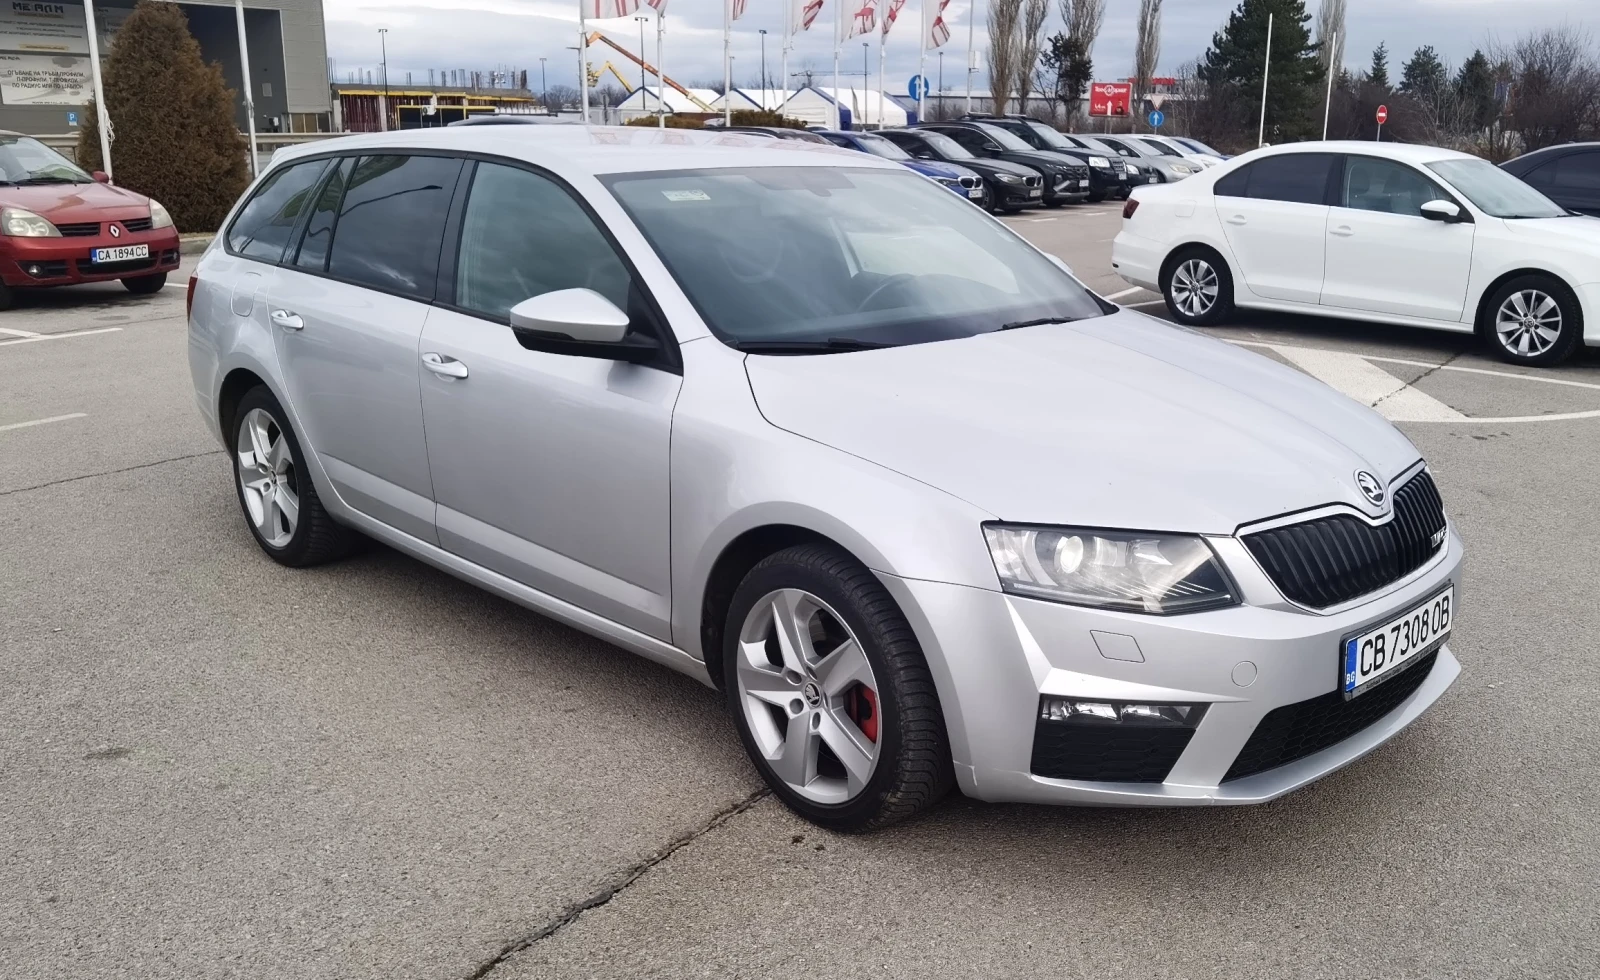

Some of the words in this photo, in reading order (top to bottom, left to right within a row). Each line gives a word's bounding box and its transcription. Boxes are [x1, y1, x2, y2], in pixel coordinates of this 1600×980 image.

[69, 113, 75, 121] P
[113, 248, 134, 259] 1894
[1360, 633, 1386, 677] CB
[1389, 608, 1429, 663] 7308
[1345, 671, 1356, 686] BG
